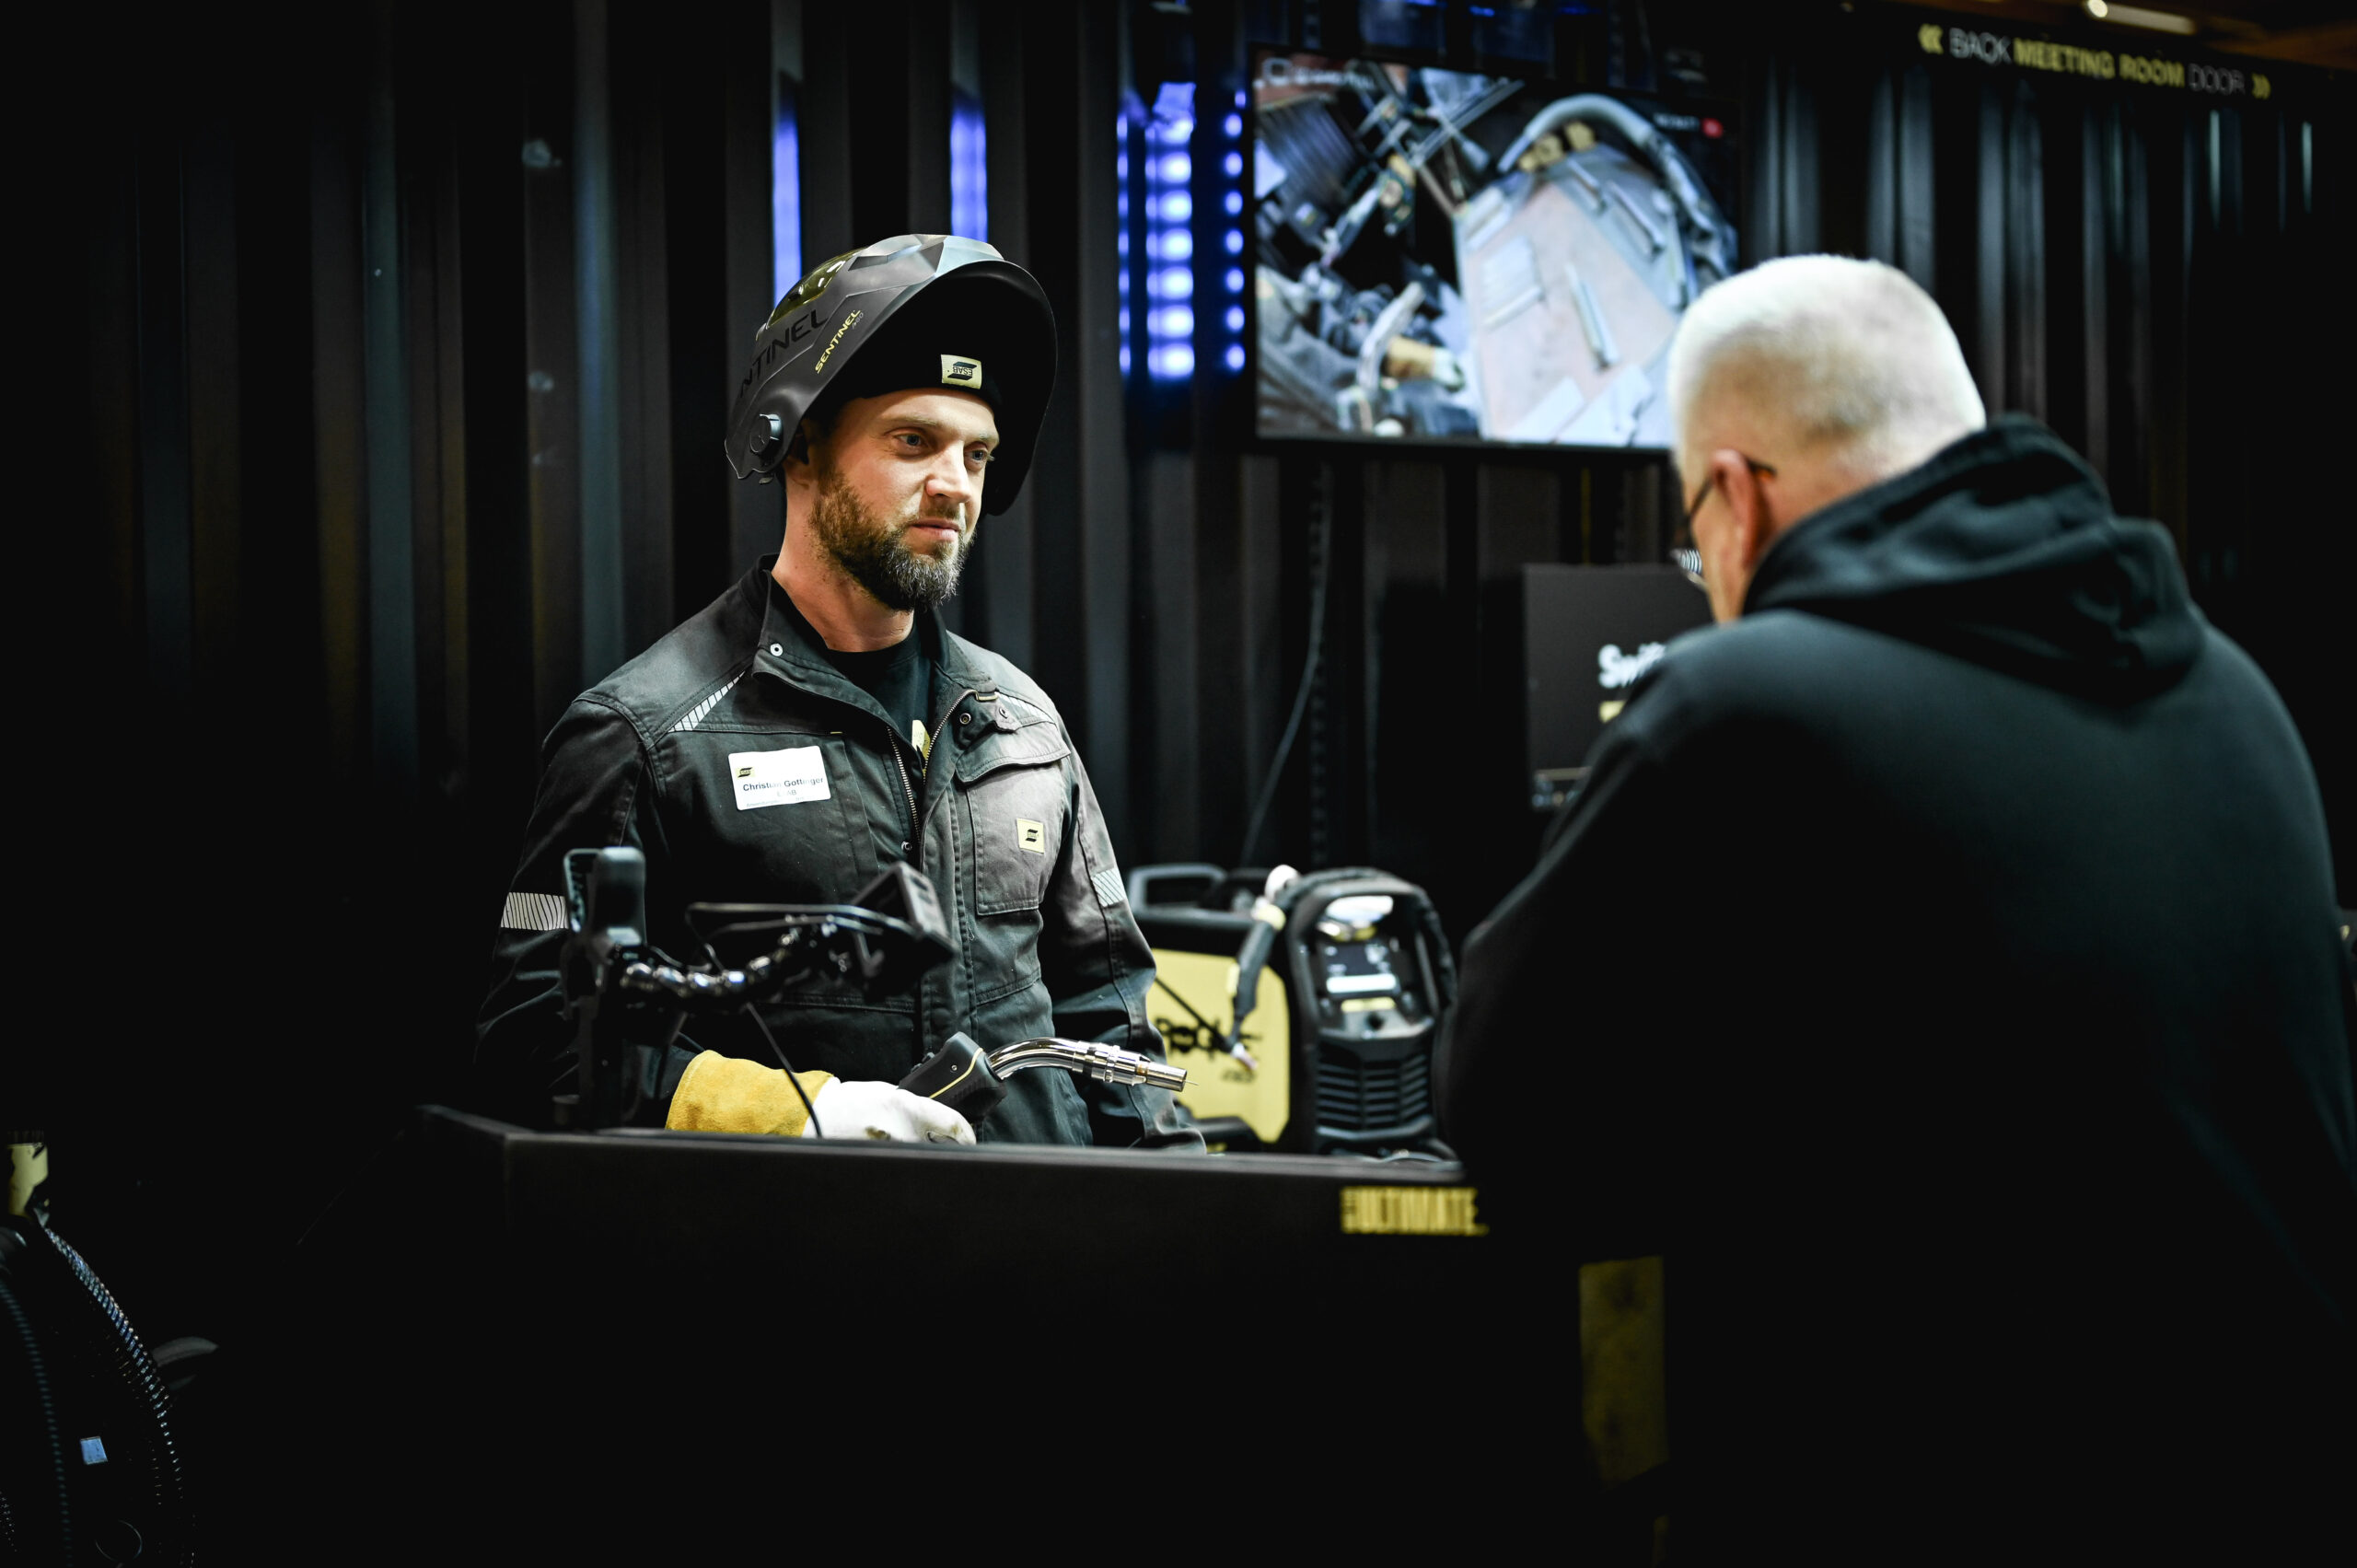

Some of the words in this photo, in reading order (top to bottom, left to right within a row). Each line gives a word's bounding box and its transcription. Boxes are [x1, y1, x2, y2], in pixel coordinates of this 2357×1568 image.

[2014, 38, 2115, 79] MEETING
[2119, 53, 2185, 87] ROOM
[740, 309, 829, 398] NTINEL
[815, 310, 861, 374] SENTINEL
